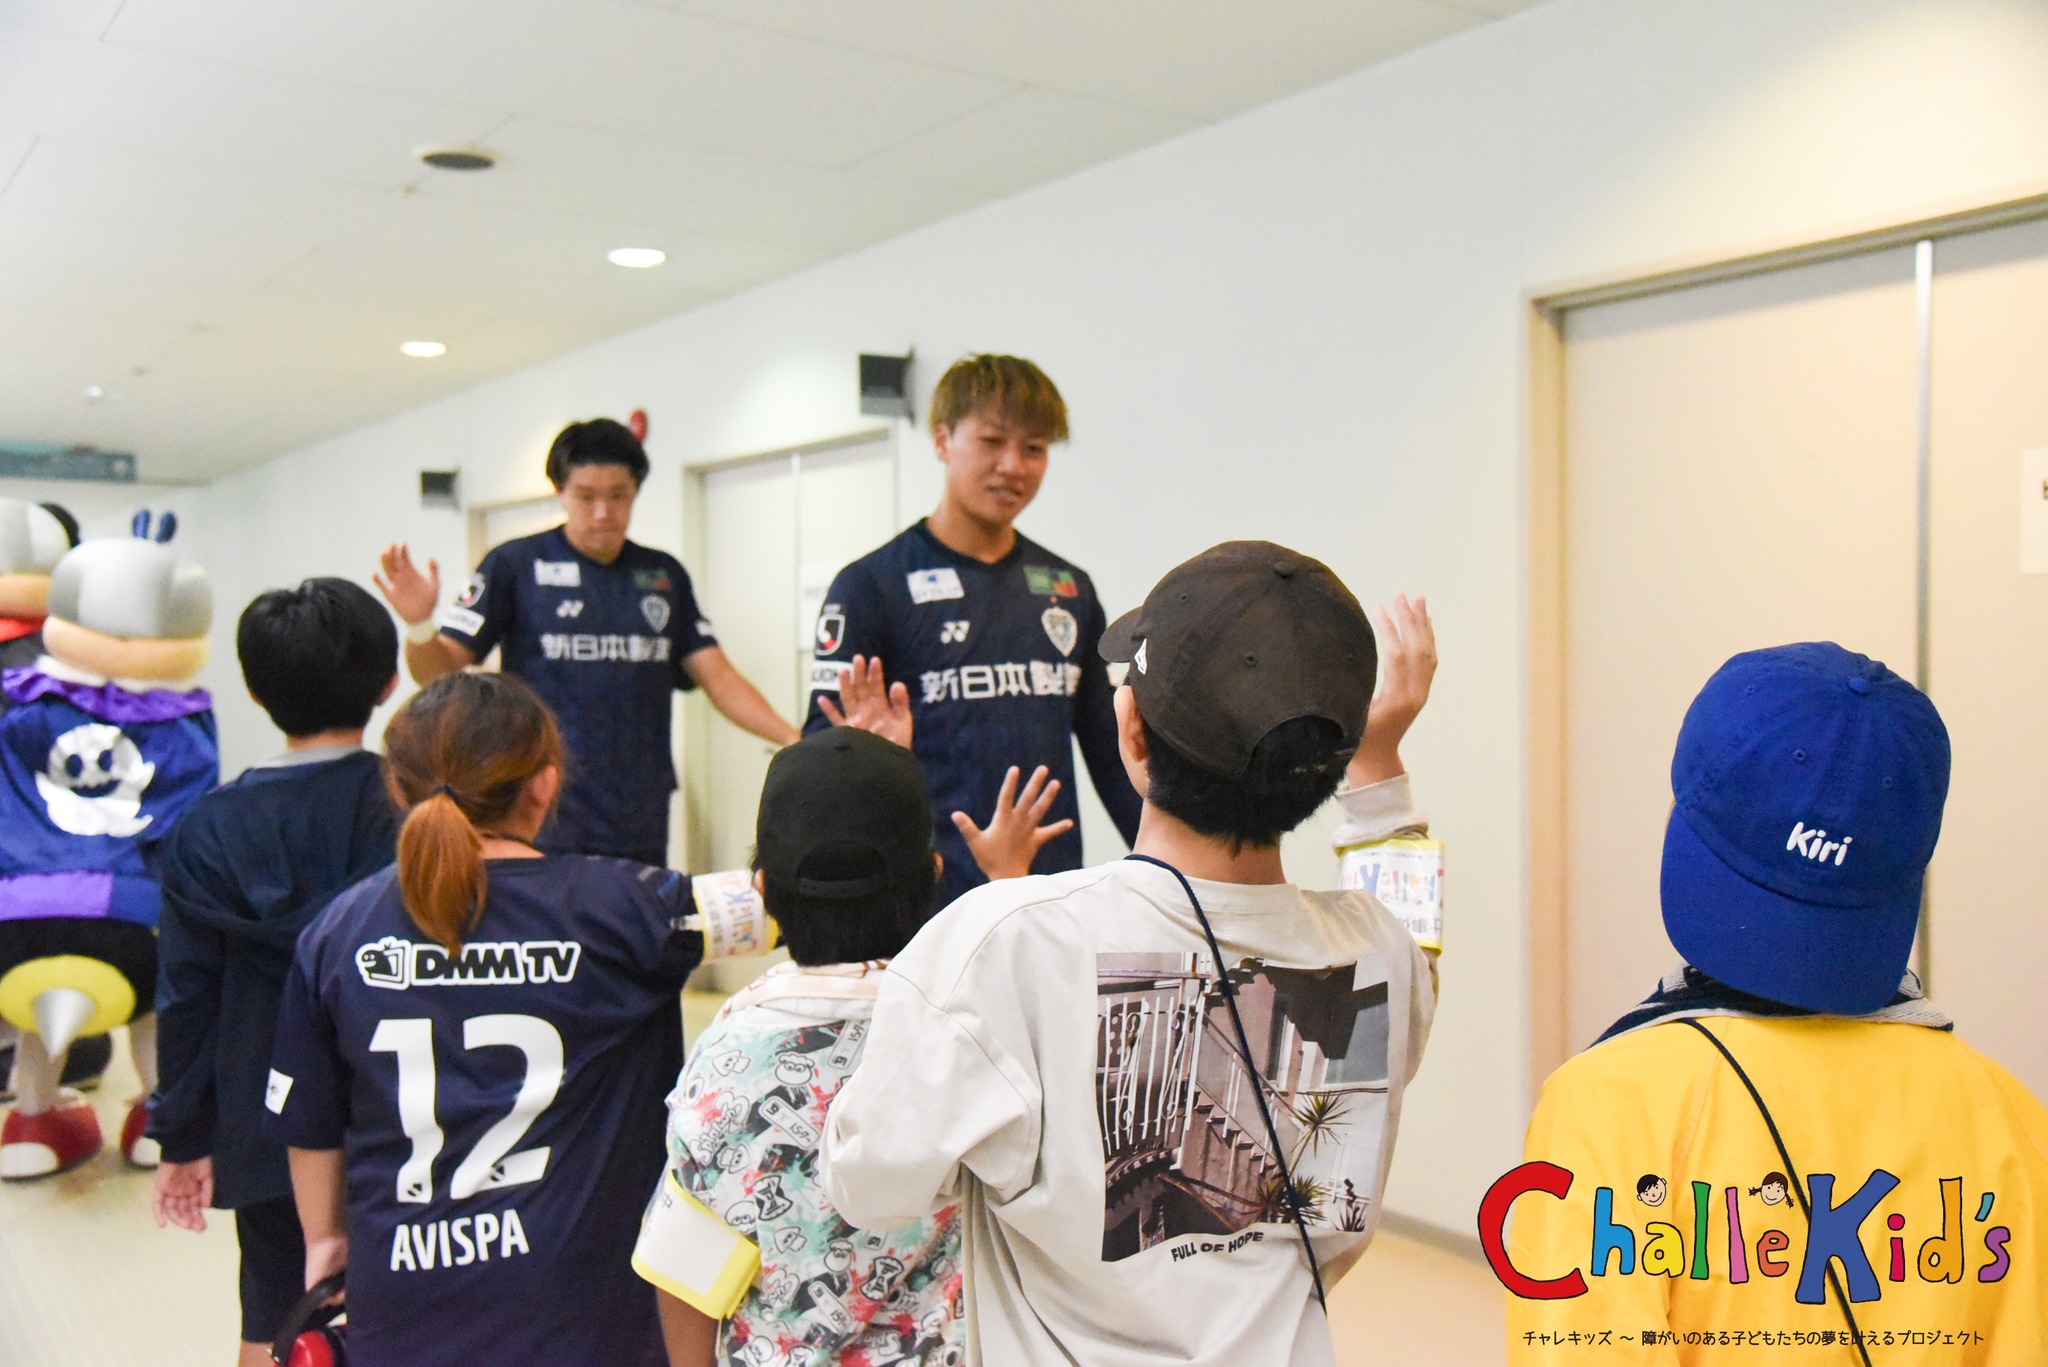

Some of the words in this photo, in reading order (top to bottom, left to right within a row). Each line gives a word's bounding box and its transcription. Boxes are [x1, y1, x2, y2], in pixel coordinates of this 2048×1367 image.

[1786, 821, 1853, 866] Kiri
[414, 946, 521, 981] DMM
[525, 946, 577, 979] TV
[370, 1014, 564, 1204] 12
[390, 1208, 530, 1272] AVISPA
[1171, 1242, 1197, 1262] FULL
[1200, 1243, 1225, 1253] OF
[1228, 1231, 1264, 1253] HOPE
